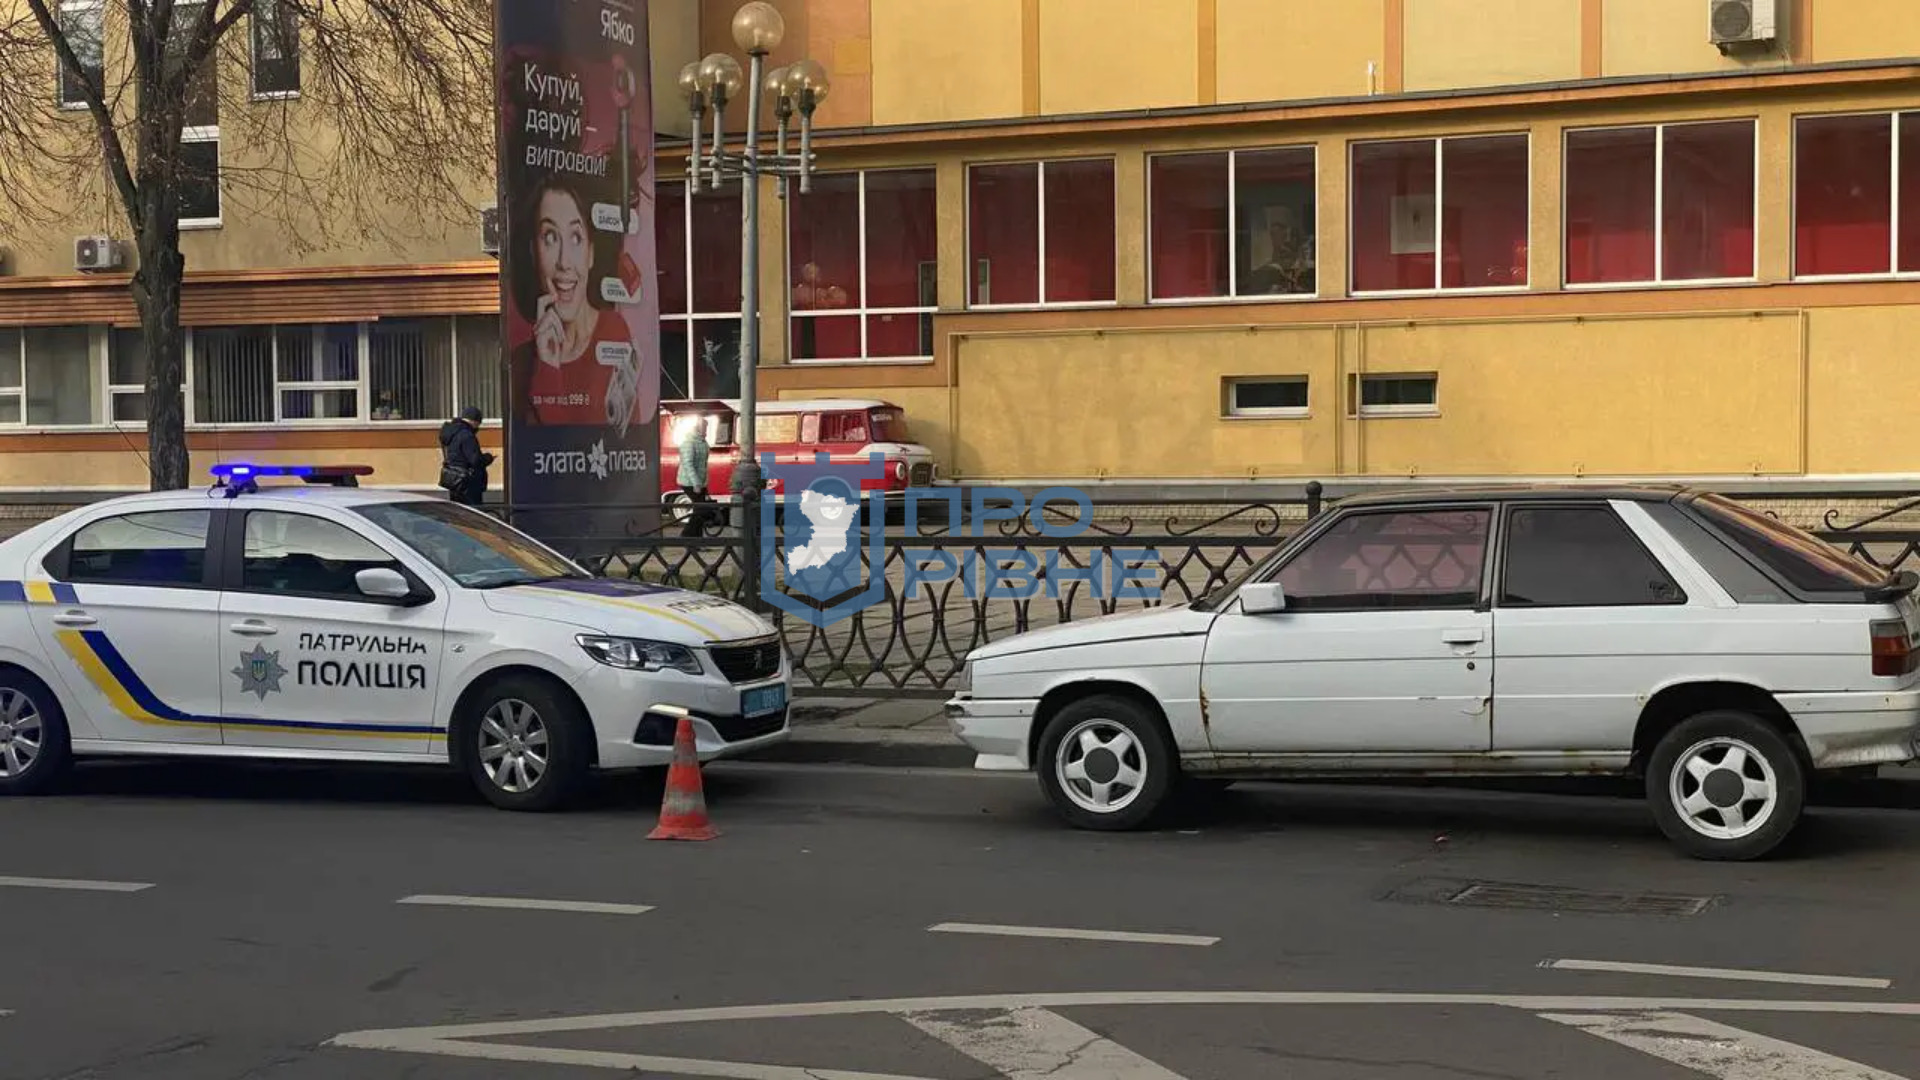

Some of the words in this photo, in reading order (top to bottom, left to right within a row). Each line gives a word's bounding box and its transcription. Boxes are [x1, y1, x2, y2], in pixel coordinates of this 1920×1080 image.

[600, 9, 634, 46] Ябко
[524, 62, 583, 106] Купуй,
[525, 109, 581, 141] даруй
[534, 451, 586, 475] злата
[608, 450, 647, 471] плаза
[298, 660, 426, 690] ПОЛІЦІЯ
